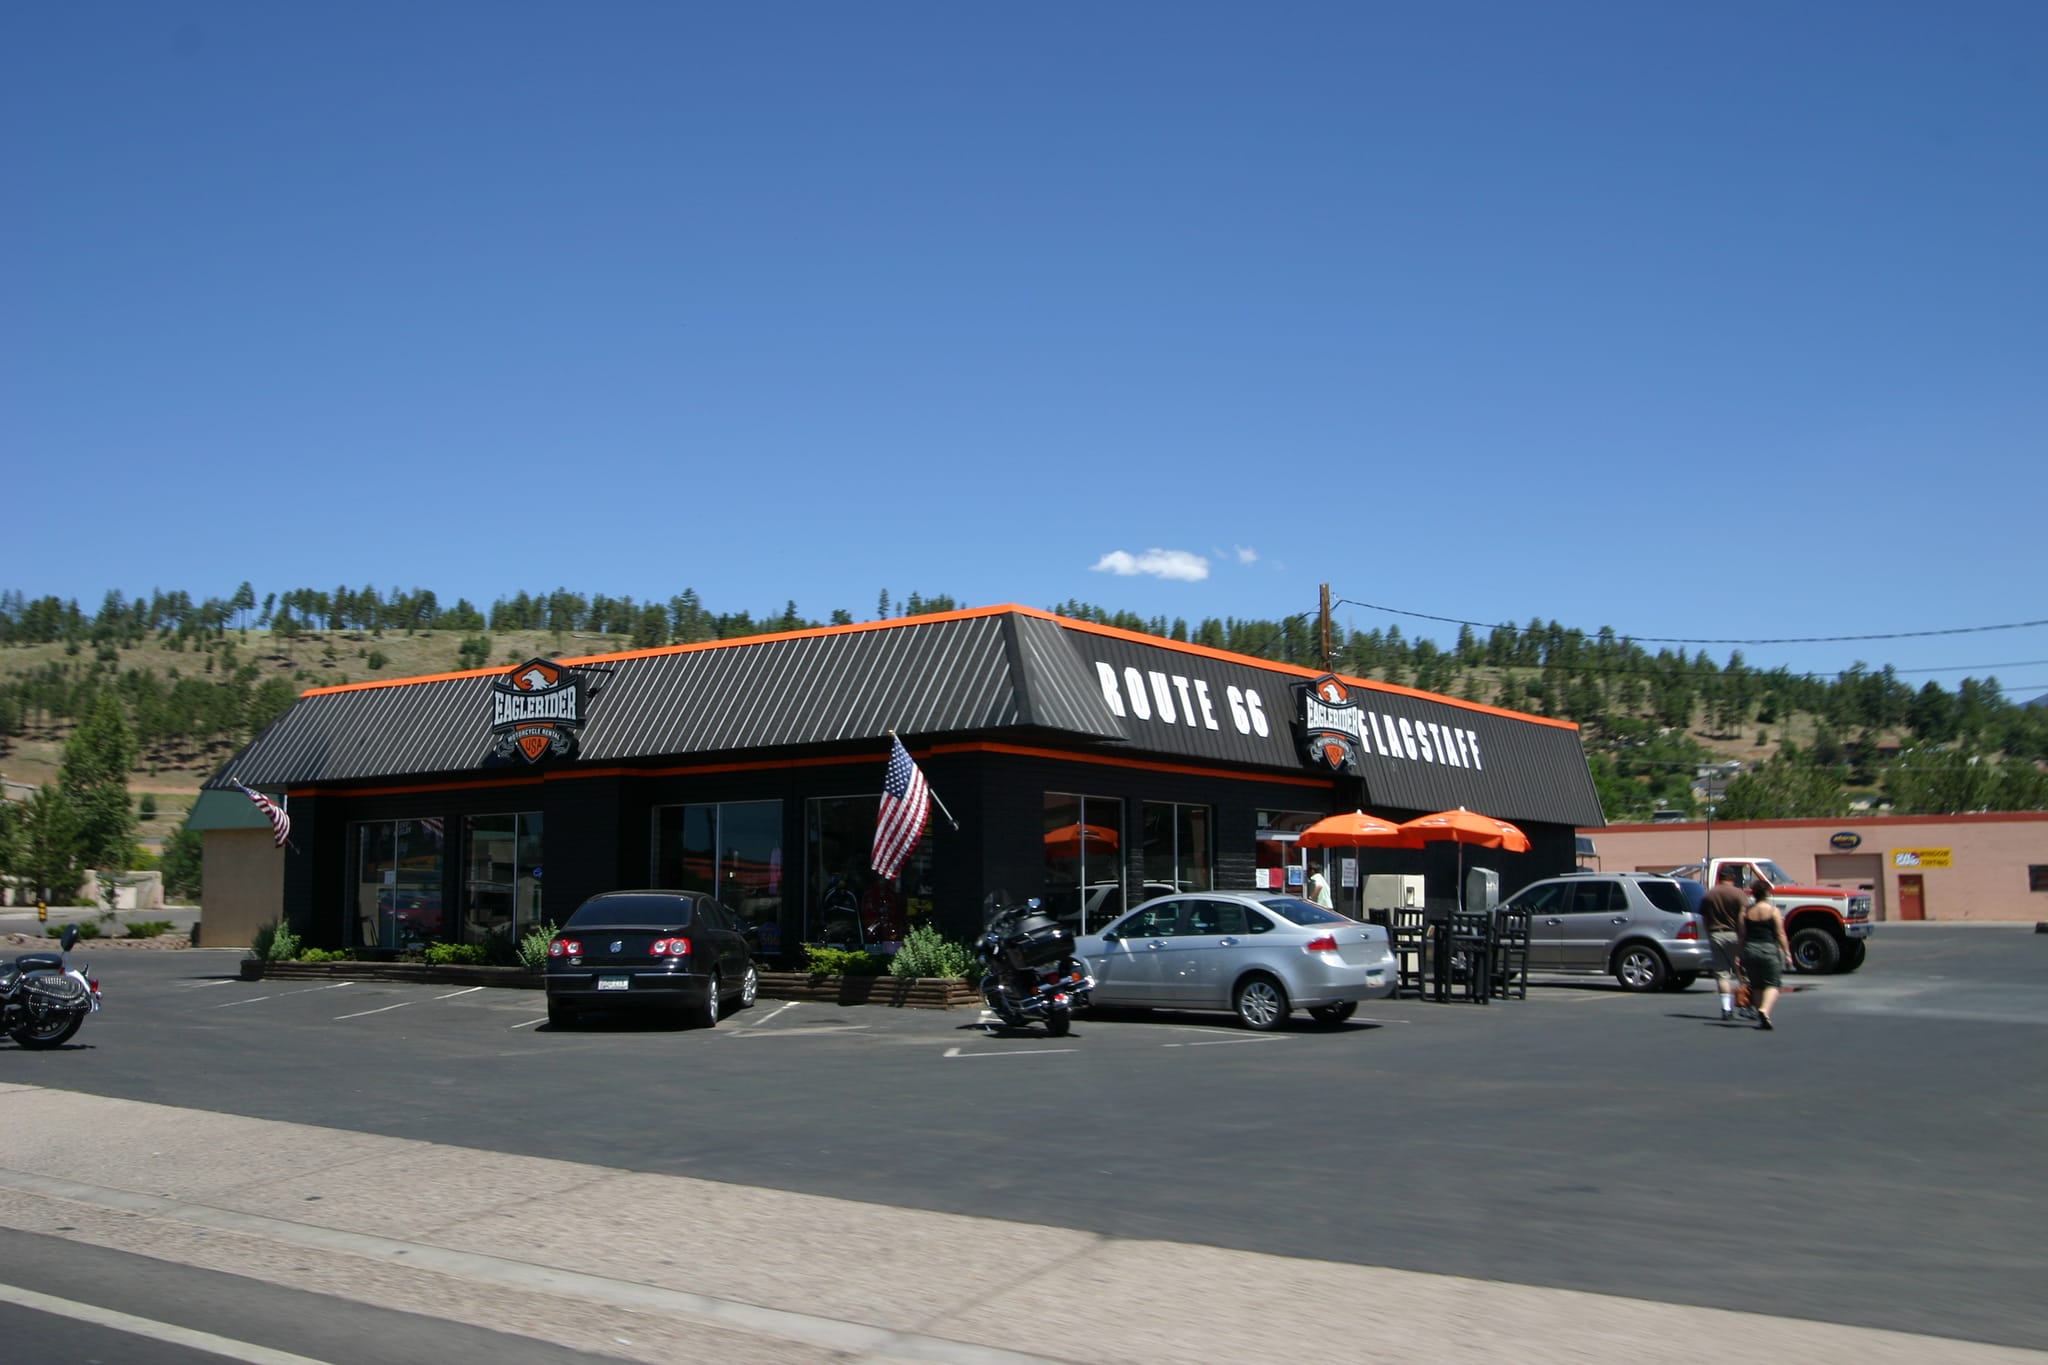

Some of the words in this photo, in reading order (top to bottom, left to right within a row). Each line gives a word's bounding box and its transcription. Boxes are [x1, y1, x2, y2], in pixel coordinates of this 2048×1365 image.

[494, 685, 577, 726] EAGLERIDER
[1095, 662, 1219, 731] ROUTE
[1227, 685, 1269, 738] 66
[1306, 695, 1359, 738] EAGLERIDER
[507, 728, 541, 742] MOTORCYCLE
[541, 728, 561, 740] RENTAL
[525, 738, 543, 754] USA
[1358, 709, 1482, 771] FLAGSTAFF
